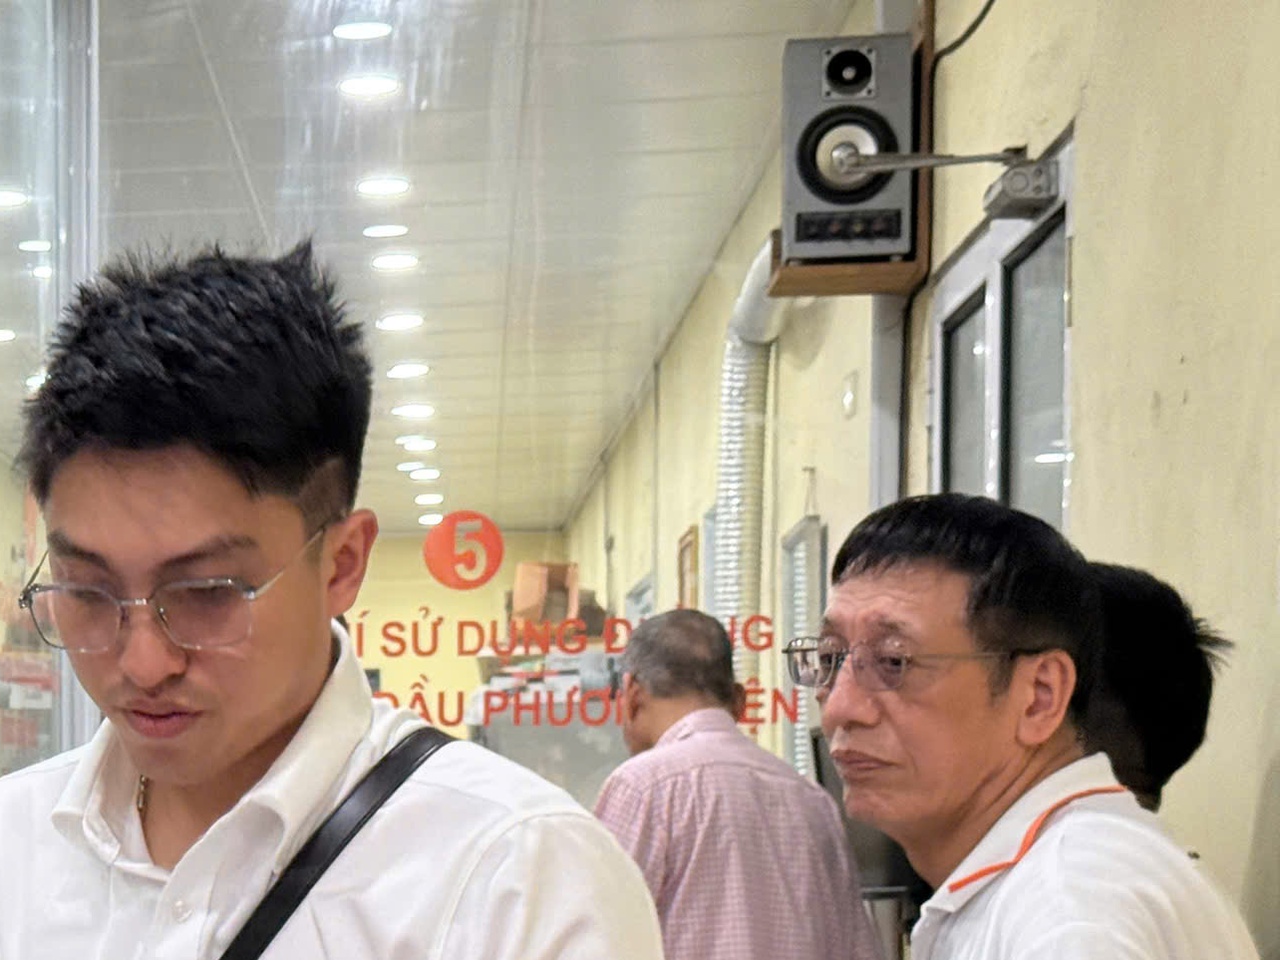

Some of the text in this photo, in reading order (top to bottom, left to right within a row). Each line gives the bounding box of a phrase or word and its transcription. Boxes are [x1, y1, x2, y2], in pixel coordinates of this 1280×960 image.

[453, 519, 488, 582] 5
[379, 606, 443, 658] SỬ
[457, 617, 588, 667] DỤNG
[482, 684, 625, 728] PHƯƠ
[739, 675, 800, 736] ỆN
